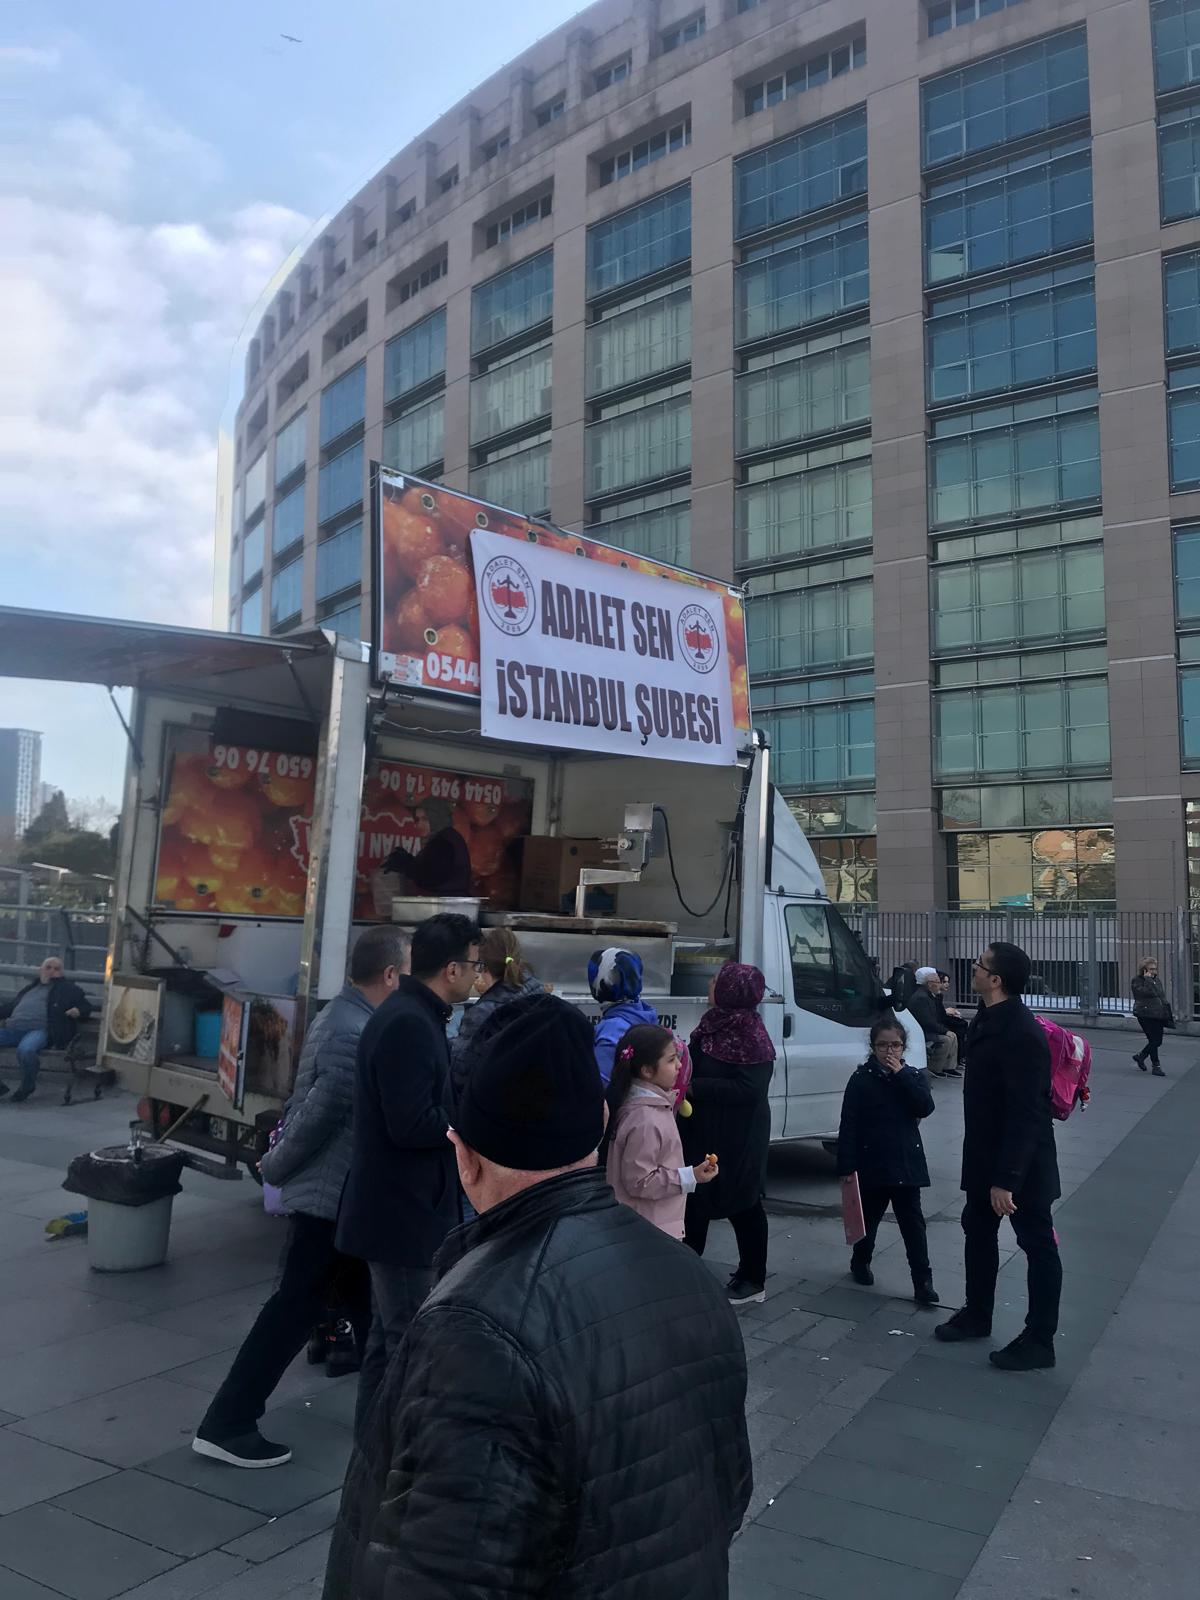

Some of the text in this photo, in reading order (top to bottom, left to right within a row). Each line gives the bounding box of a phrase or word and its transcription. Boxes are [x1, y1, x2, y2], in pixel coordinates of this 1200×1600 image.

[541, 579, 675, 662] ADALET SEN
[426, 652, 480, 687] 0544
[214, 745, 313, 778] 650 76 06
